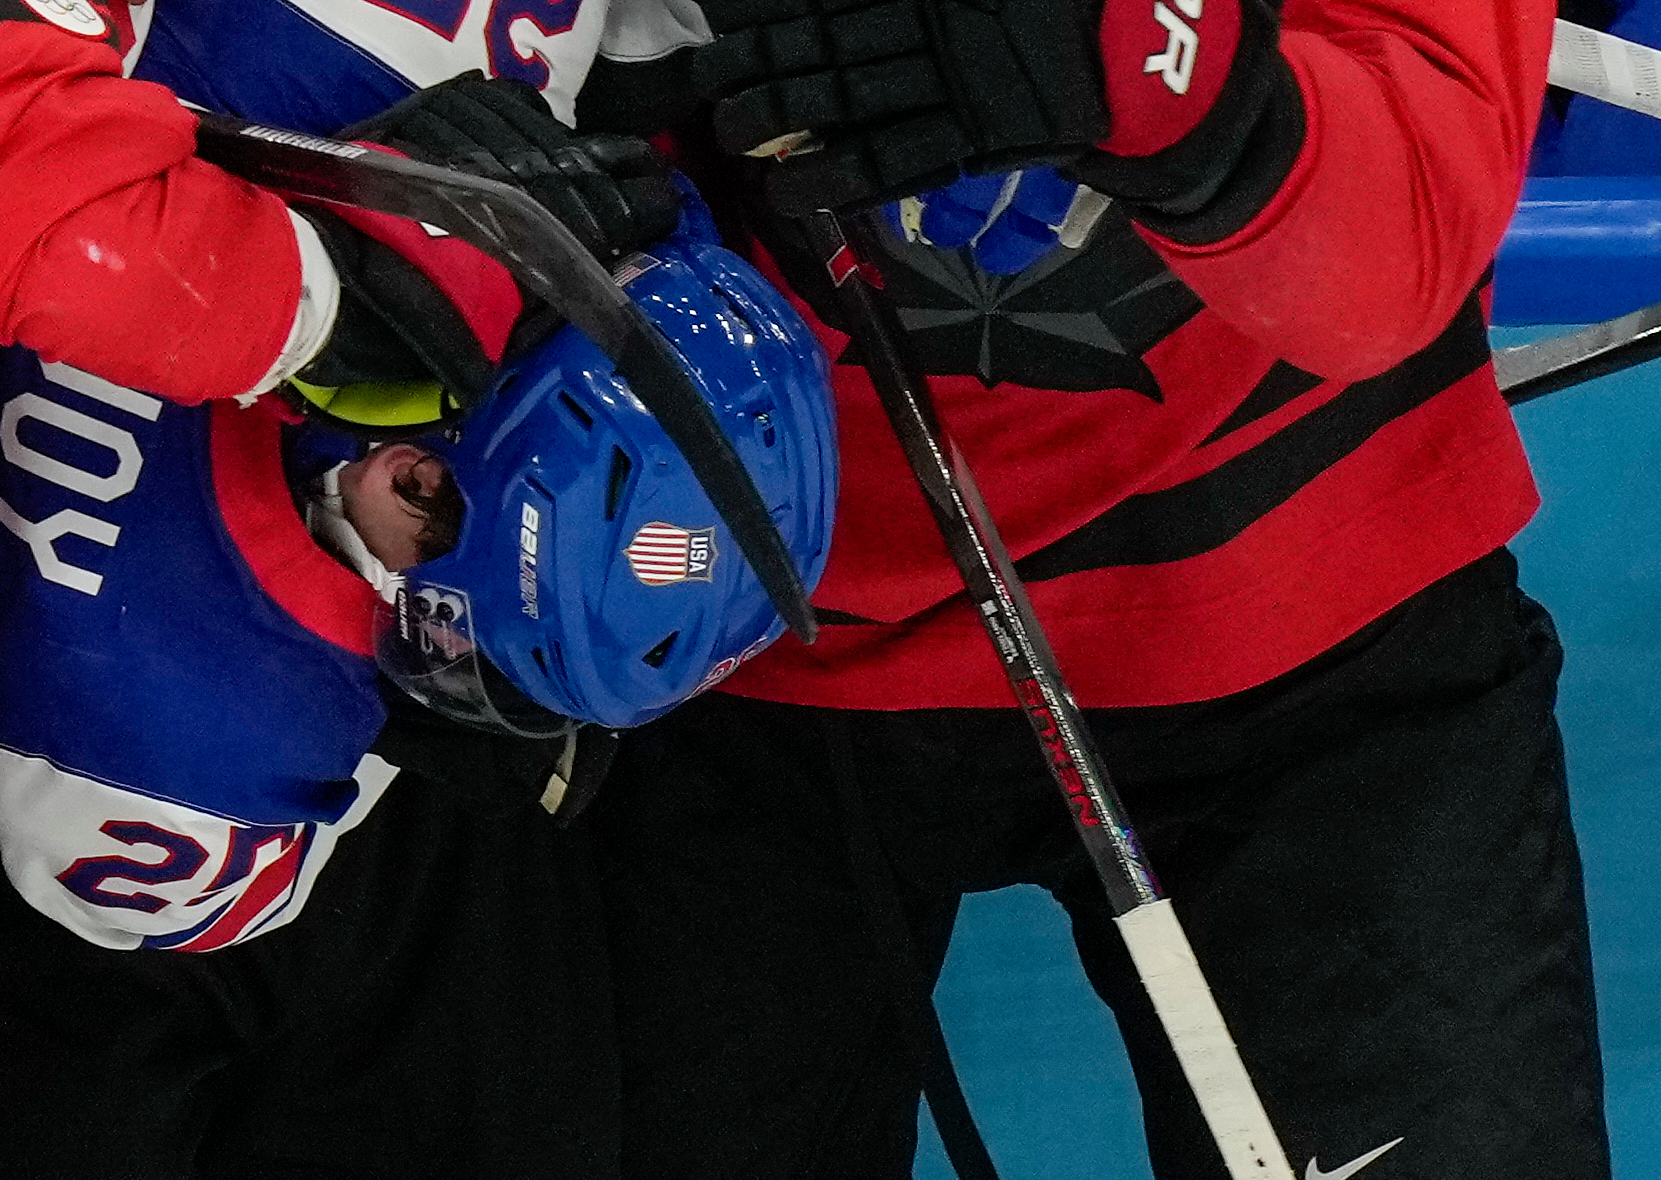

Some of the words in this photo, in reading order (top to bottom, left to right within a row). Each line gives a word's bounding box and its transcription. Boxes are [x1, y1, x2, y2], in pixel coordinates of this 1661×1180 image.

[519, 501, 540, 620] BAUER
[689, 535, 710, 573] USA
[1015, 676, 1102, 826] NEXUS
